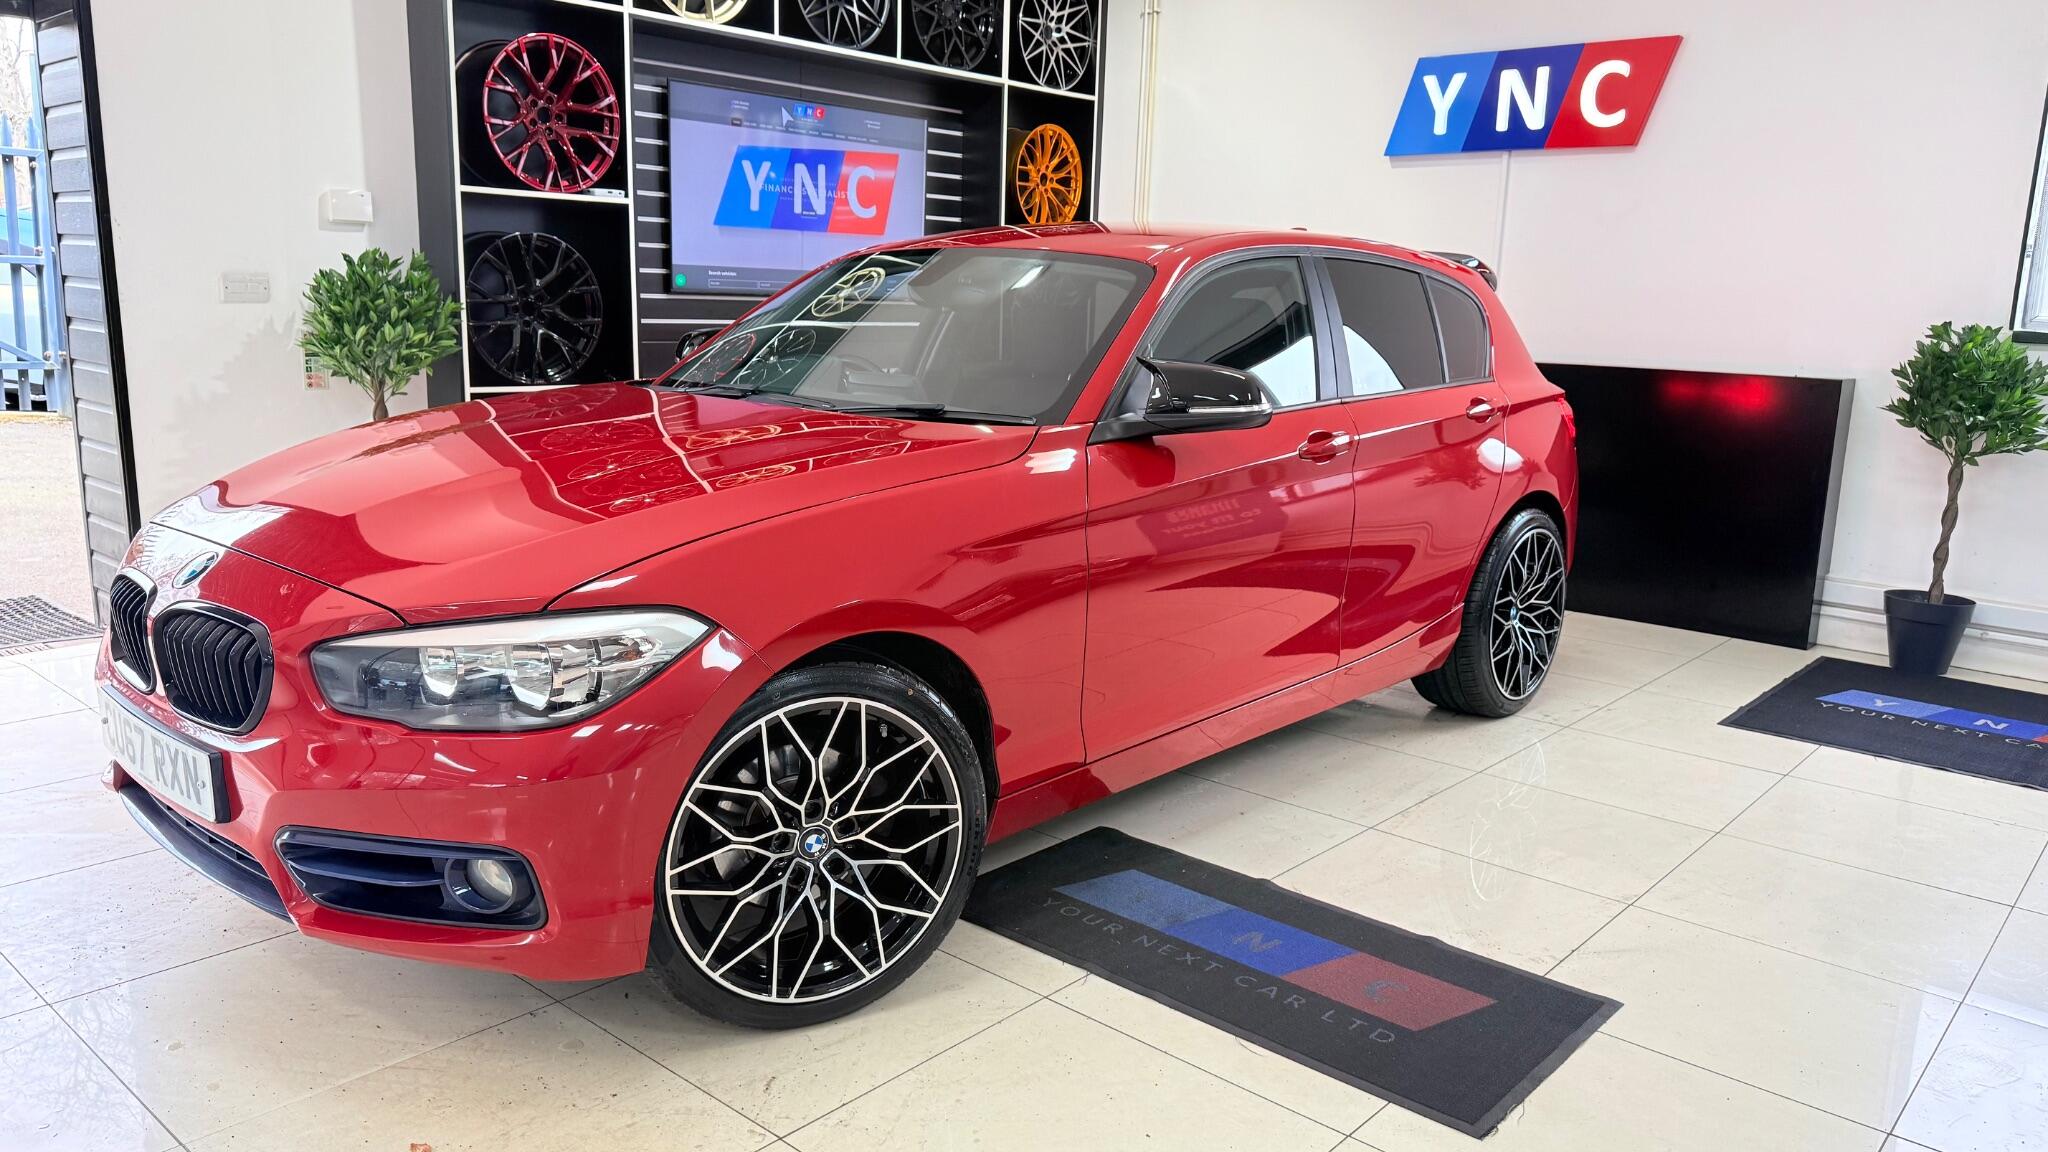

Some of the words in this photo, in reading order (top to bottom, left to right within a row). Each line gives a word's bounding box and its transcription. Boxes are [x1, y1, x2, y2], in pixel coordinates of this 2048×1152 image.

[1422, 59, 1631, 136] YNC
[741, 159, 877, 219] YNC
[761, 183, 799, 194] FINANC
[1821, 702, 1895, 720] YOUR
[1911, 719, 1989, 738] NEXT
[2005, 738, 2043, 750] CA
[151, 734, 202, 806] RXN
[1043, 897, 1123, 934] YOUR
[1134, 934, 1224, 972] NEXT
[1235, 975, 1306, 1009] CAR
[1320, 1009, 1396, 1043] LTD
